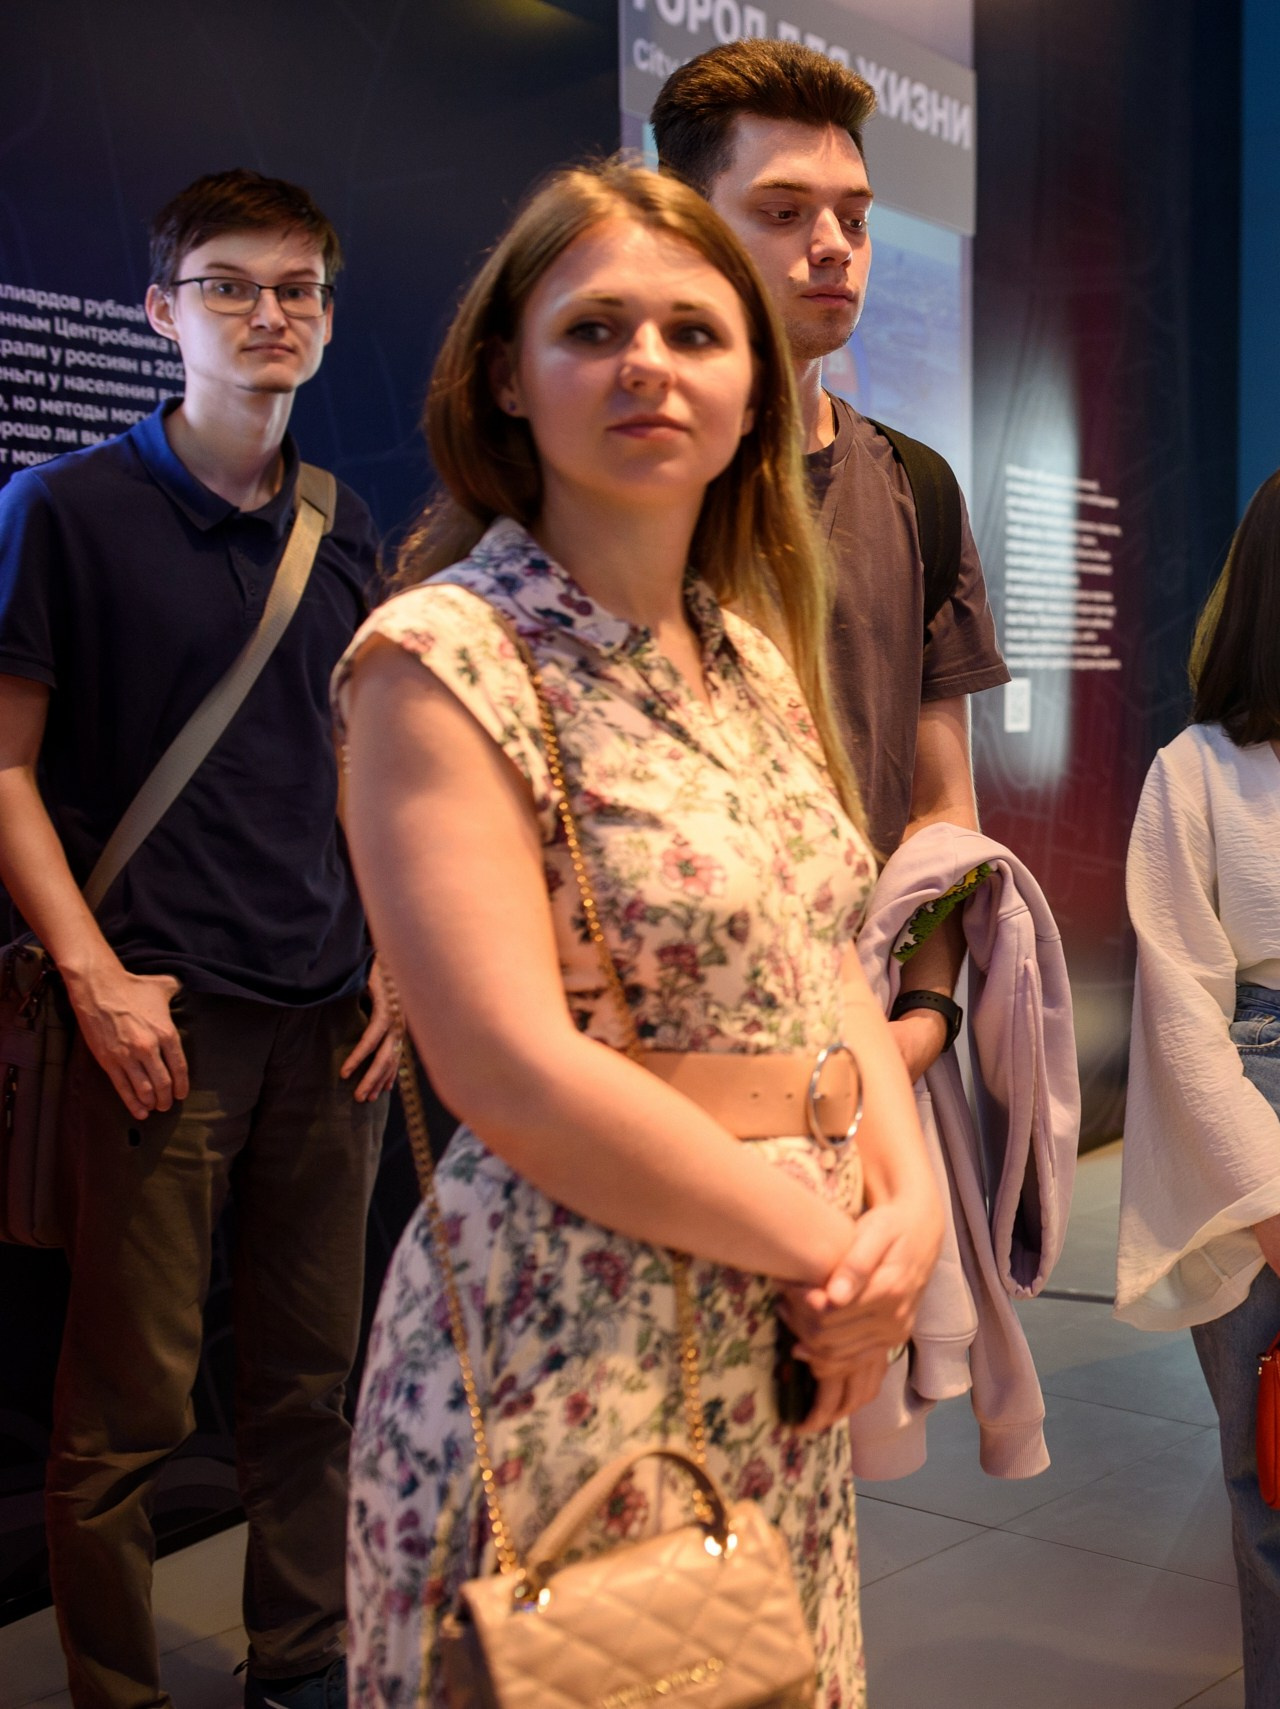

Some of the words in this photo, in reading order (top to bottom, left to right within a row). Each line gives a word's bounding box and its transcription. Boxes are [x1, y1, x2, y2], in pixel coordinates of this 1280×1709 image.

[84, 299, 147, 323] рублей
[54, 315, 169, 353] Центробанка
[0, 339, 47, 359] рали
[49, 345, 61, 366] у
[65, 348, 139, 375] россиян
[141, 359, 152, 376] в
[0, 366, 46, 387] ньги
[48, 372, 60, 393] у
[64, 374, 157, 402] населения
[12, 395, 37, 412] но
[40, 398, 107, 422] методы
[0, 421, 51, 441] рошо
[55, 427, 78, 444] ли
